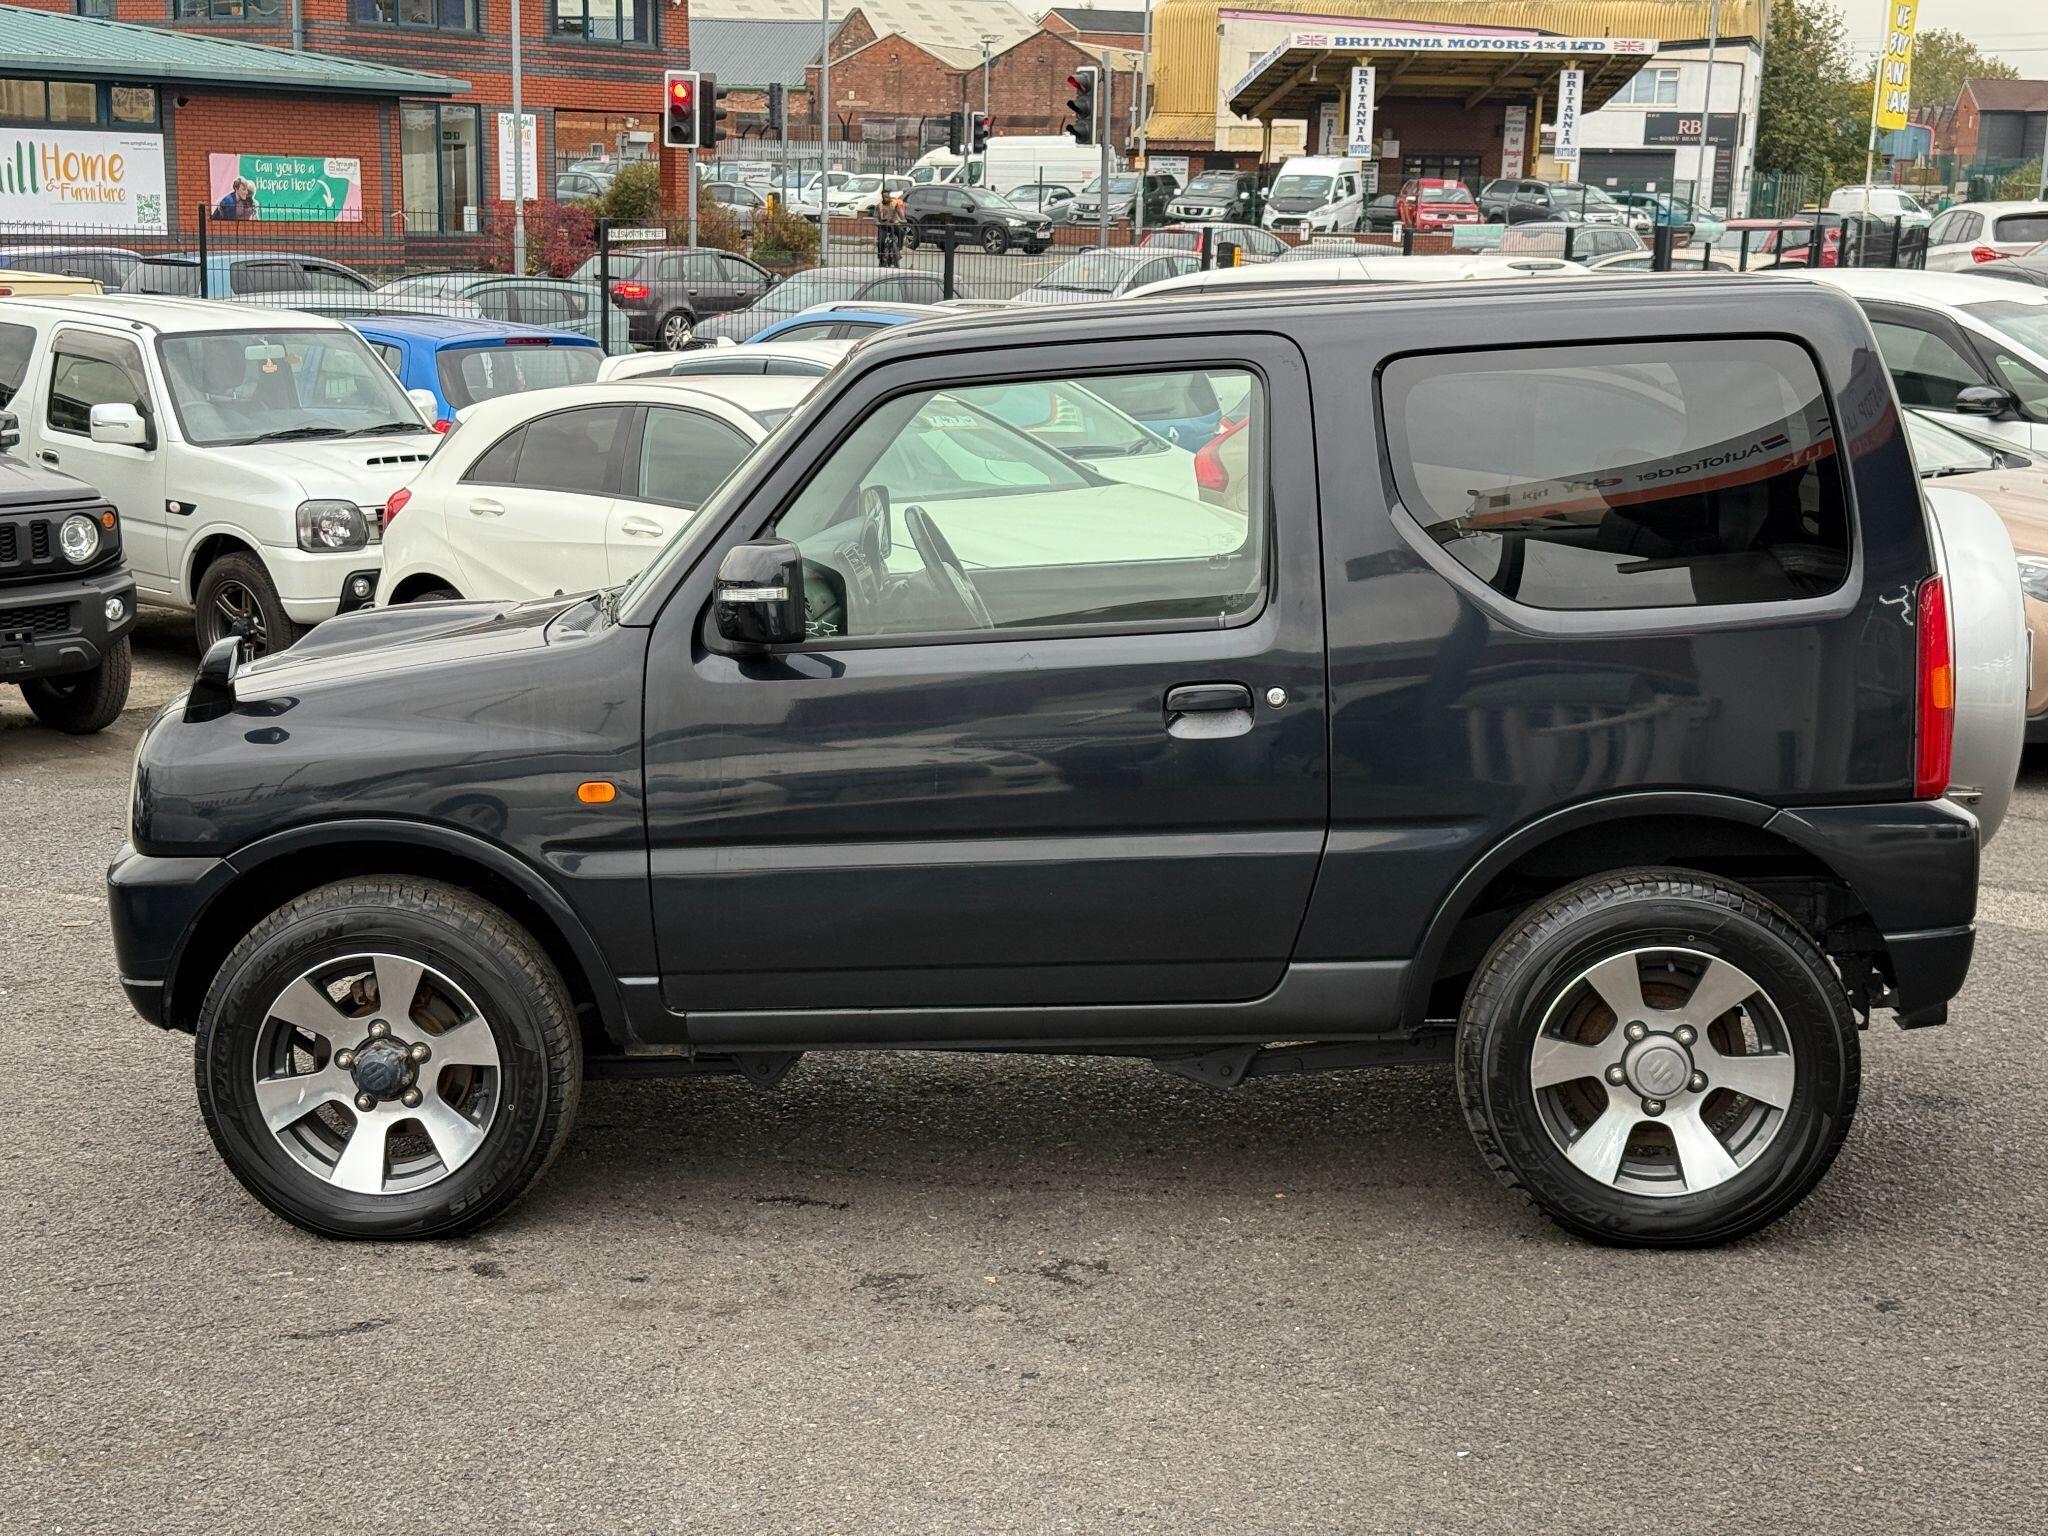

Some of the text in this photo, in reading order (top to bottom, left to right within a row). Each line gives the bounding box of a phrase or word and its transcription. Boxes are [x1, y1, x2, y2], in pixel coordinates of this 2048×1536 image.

[1334, 36, 1606, 50] BRITANNIA MOTORS 4x4 LTD
[1356, 69, 1368, 142] BRITANNIA
[1562, 72, 1577, 145] BRITANNIA
[1678, 119, 1702, 134] RB
[0, 140, 125, 194] ill Home
[255, 159, 315, 177] Can you be a
[46, 177, 126, 202] & Furniture
[255, 177, 316, 194] Hospice Hero?
